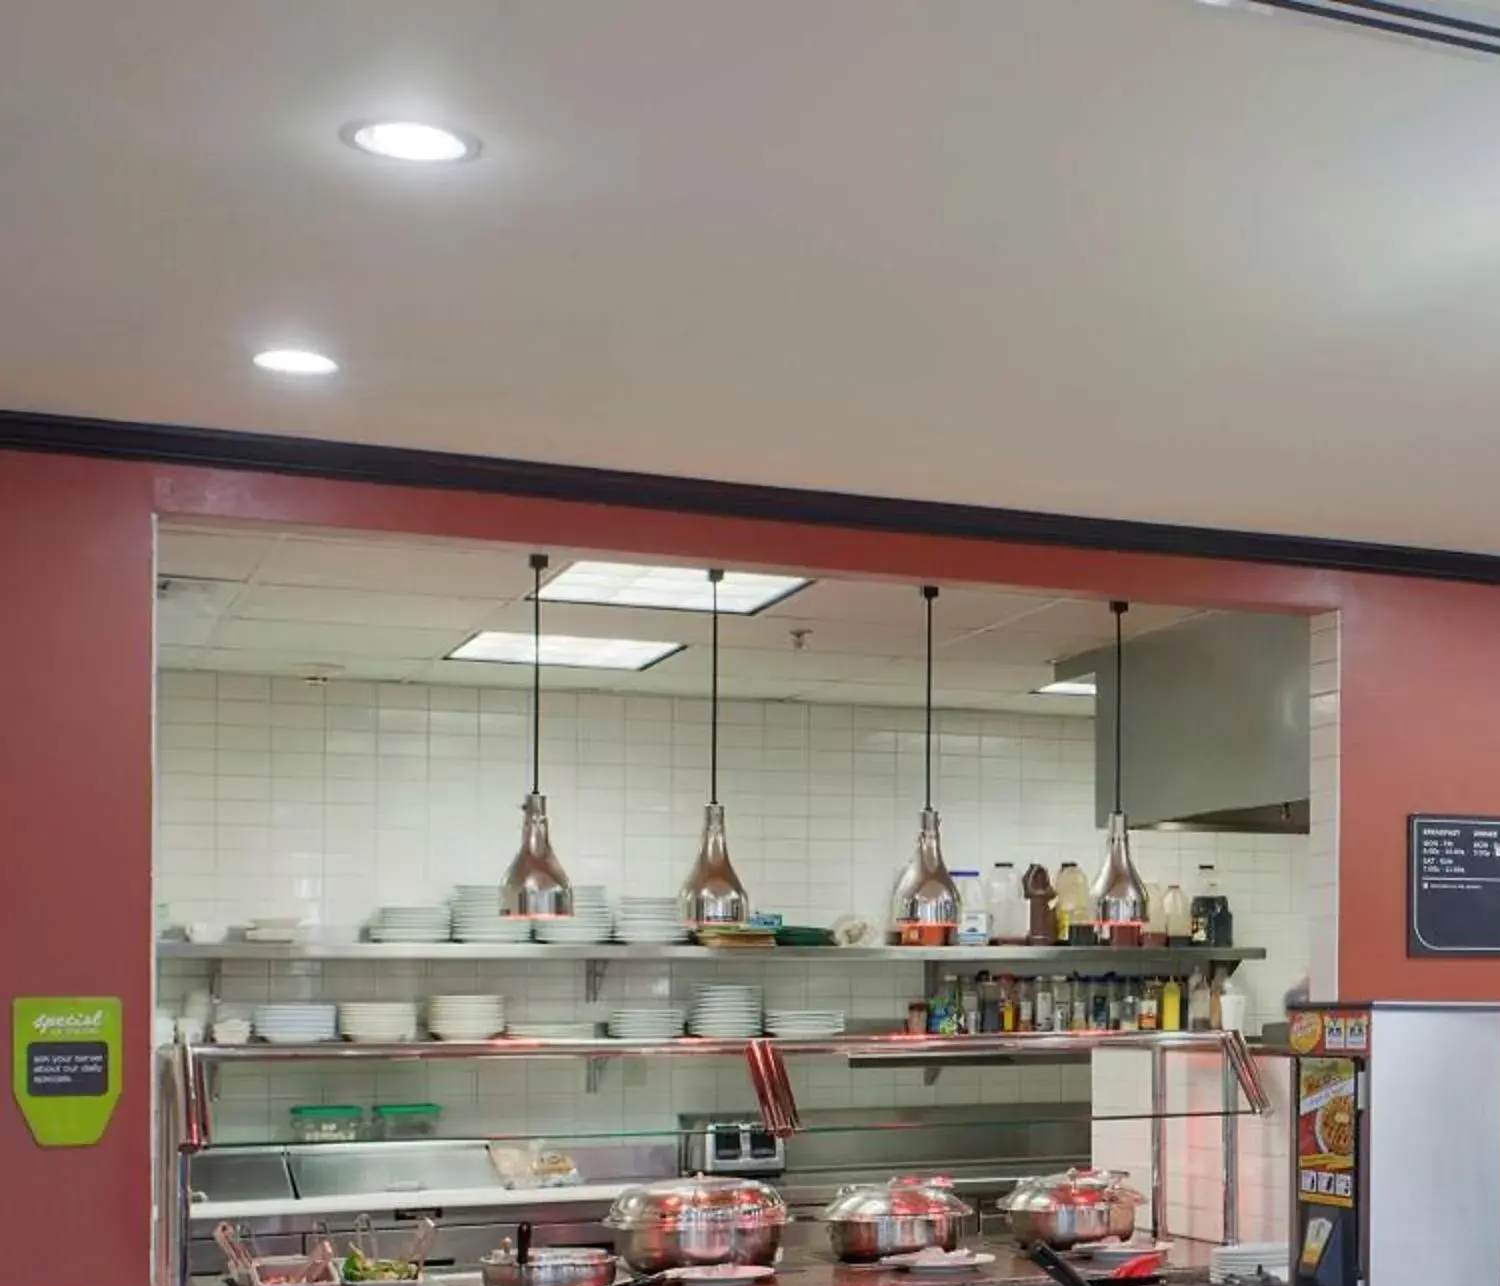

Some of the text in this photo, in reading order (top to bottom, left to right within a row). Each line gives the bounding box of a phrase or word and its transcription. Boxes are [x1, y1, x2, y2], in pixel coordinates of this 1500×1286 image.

[32, 1009, 103, 1036] special
[51, 1055, 73, 1065] your
[34, 1065, 61, 1073] about
[62, 1065, 79, 1073] our
